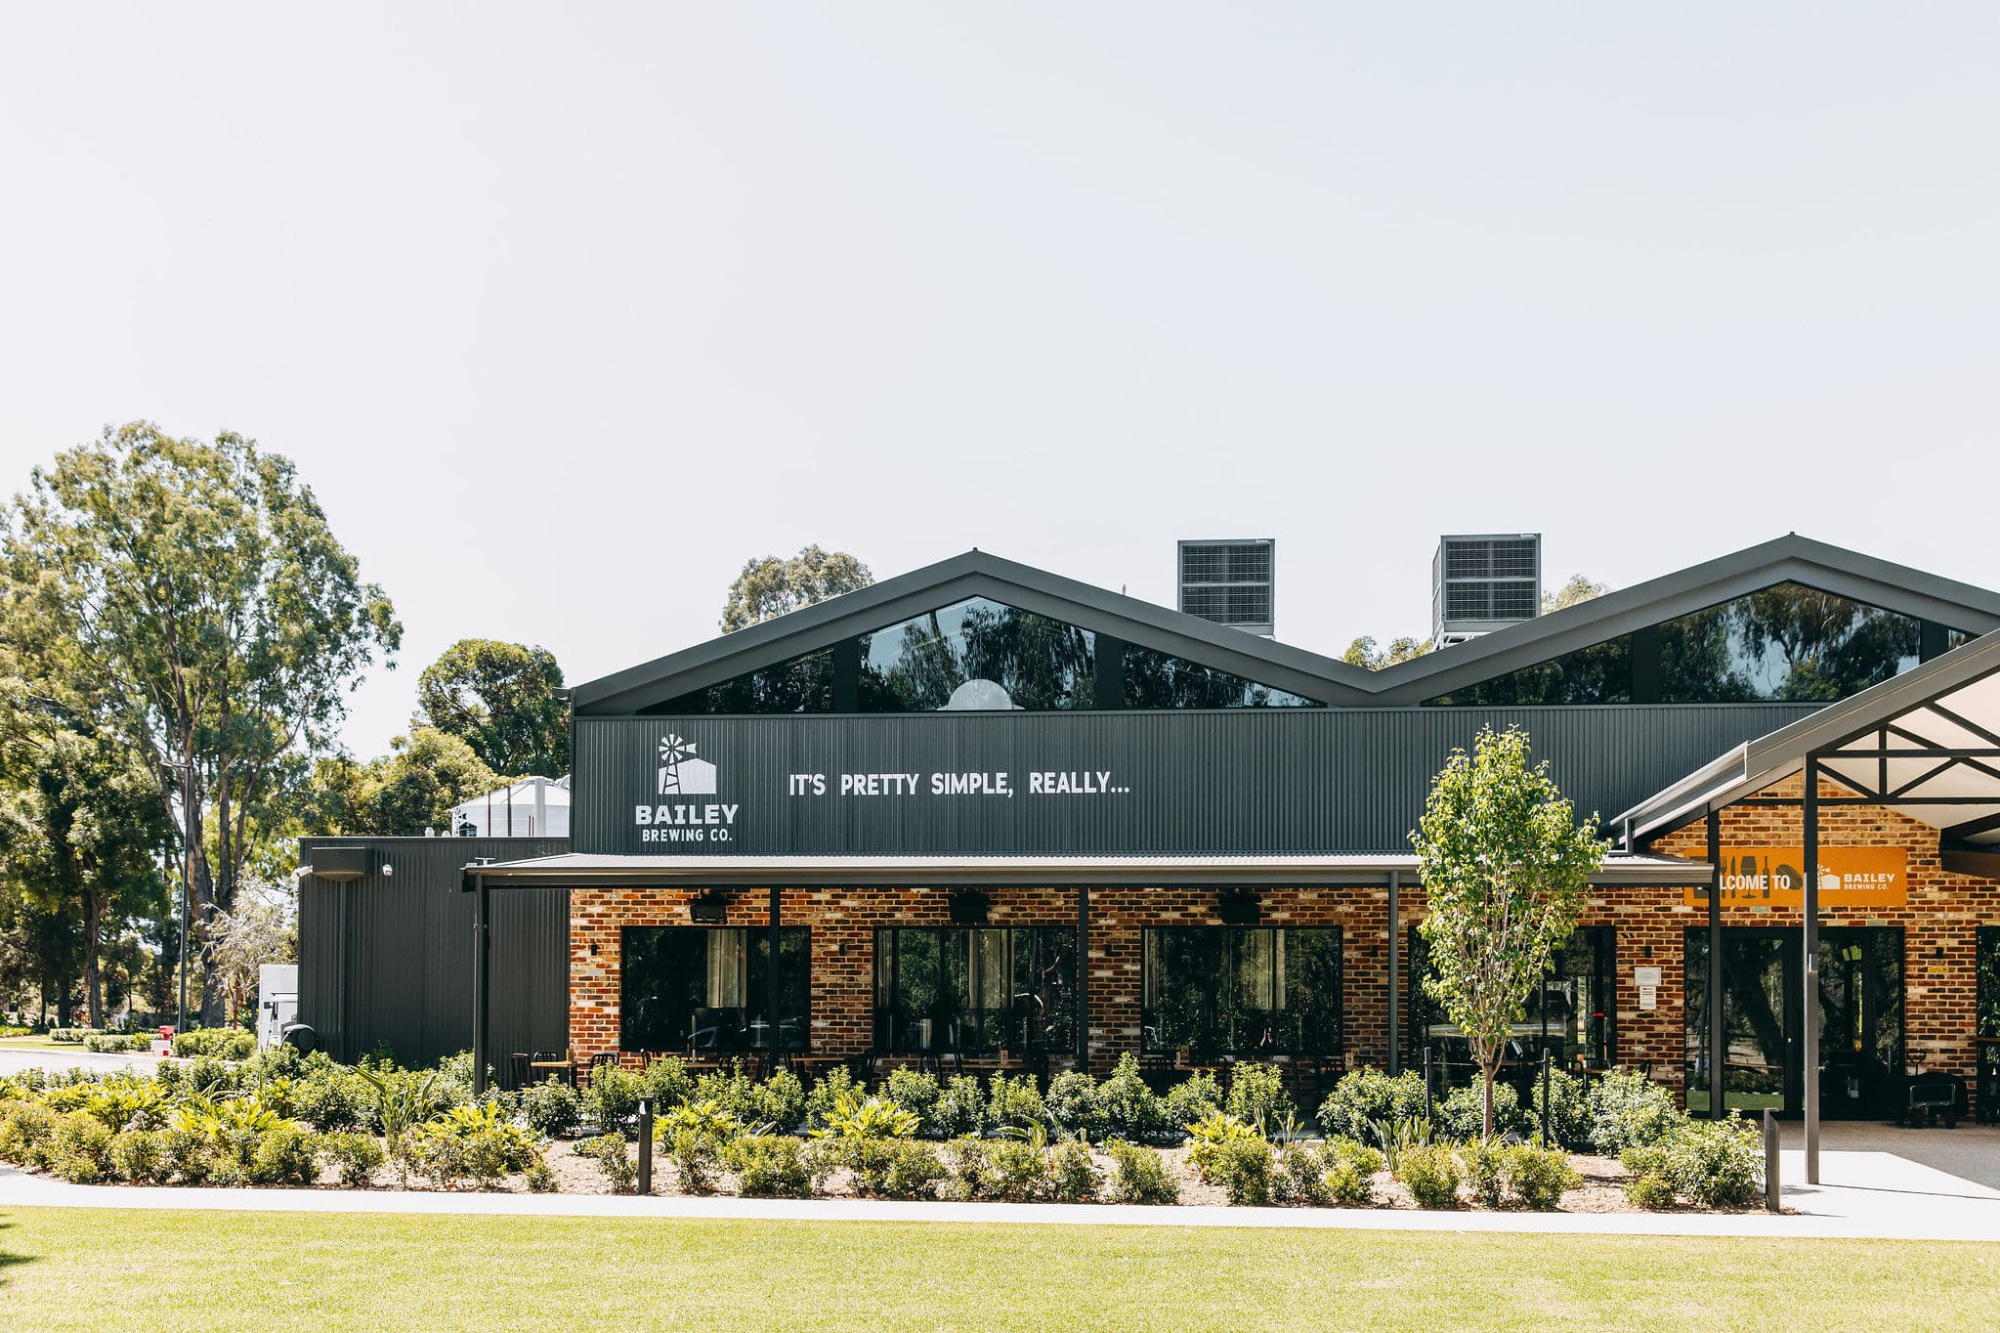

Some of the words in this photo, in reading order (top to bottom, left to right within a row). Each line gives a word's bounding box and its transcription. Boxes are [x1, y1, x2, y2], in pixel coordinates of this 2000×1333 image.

[789, 773, 826, 796] IT’S
[841, 773, 920, 796] PRETTY
[931, 772, 1013, 798] SIMPLE,
[1029, 771, 1130, 794] REALLY...
[635, 804, 739, 825] BAILEY
[642, 828, 704, 842] BREWING
[710, 828, 733, 842] CO.
[1697, 874, 1768, 890] LCOME
[1772, 875, 1791, 890] TO
[1844, 873, 1895, 883] BAILEY
